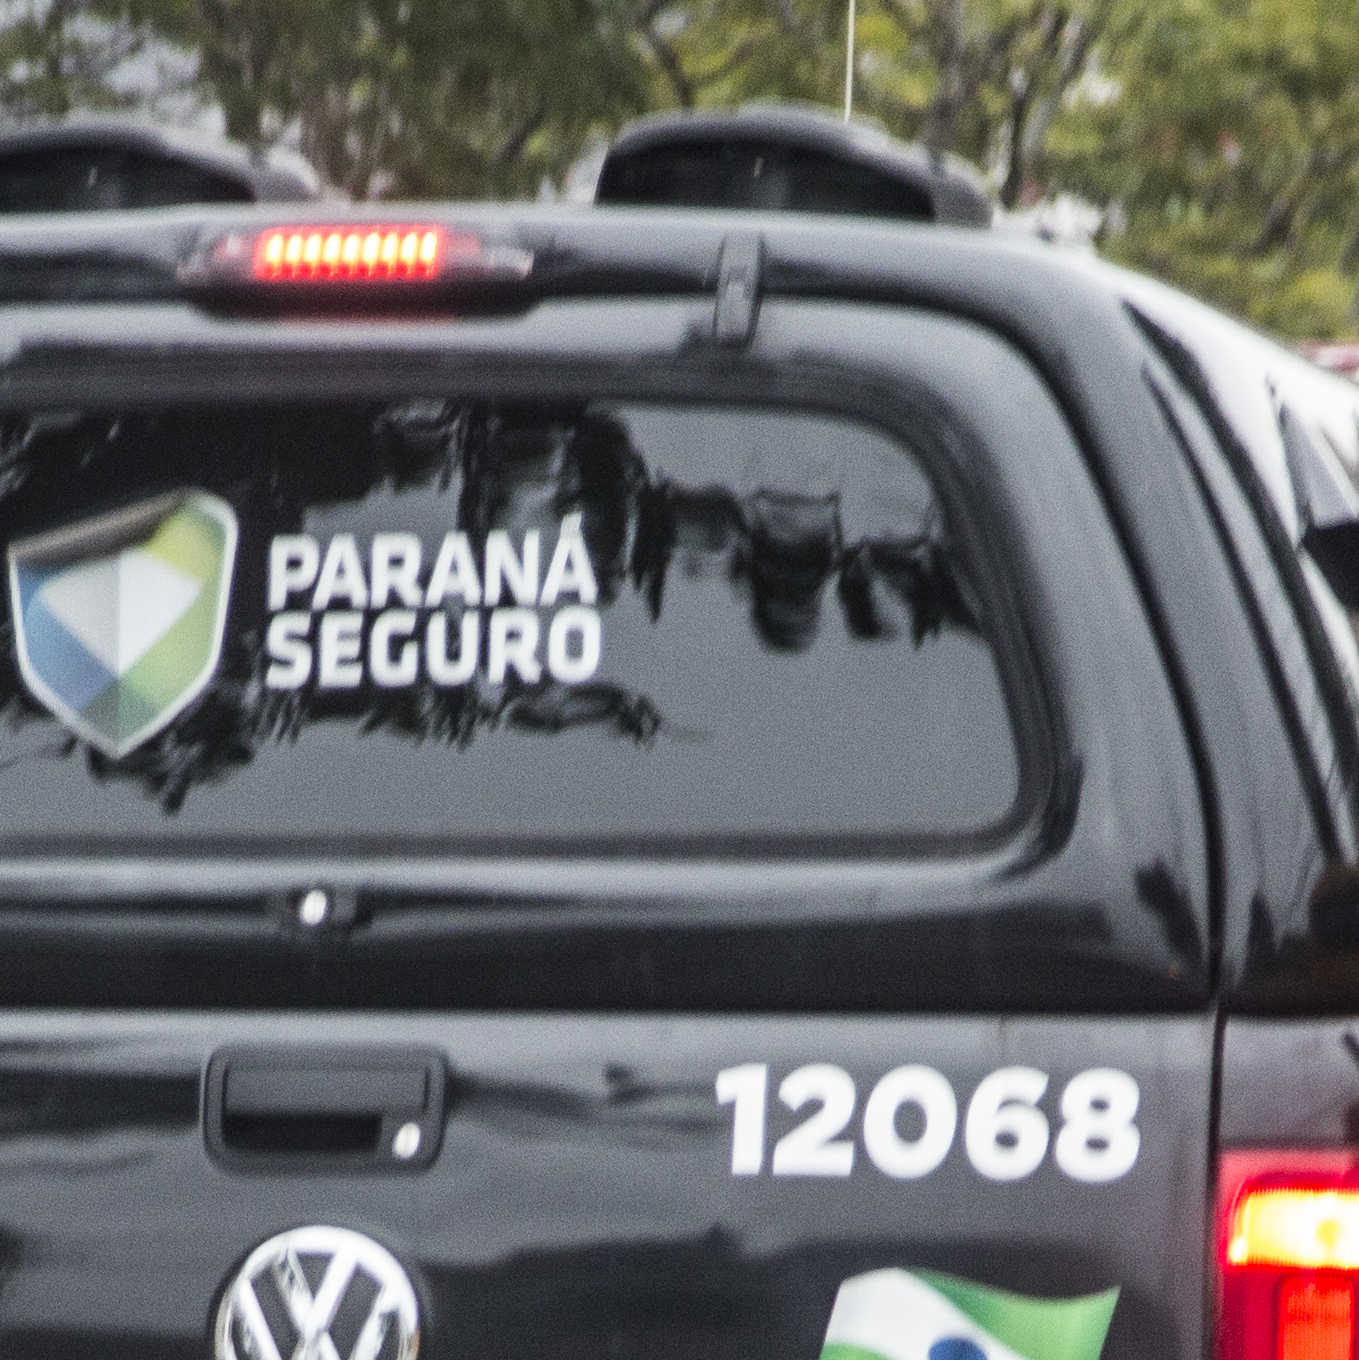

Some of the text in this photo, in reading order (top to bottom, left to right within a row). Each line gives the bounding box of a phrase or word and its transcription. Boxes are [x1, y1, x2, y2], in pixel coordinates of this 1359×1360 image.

[267, 511, 599, 612] PARANÁ
[265, 606, 602, 690] SEGURO
[715, 1063, 1141, 1183] 12068
